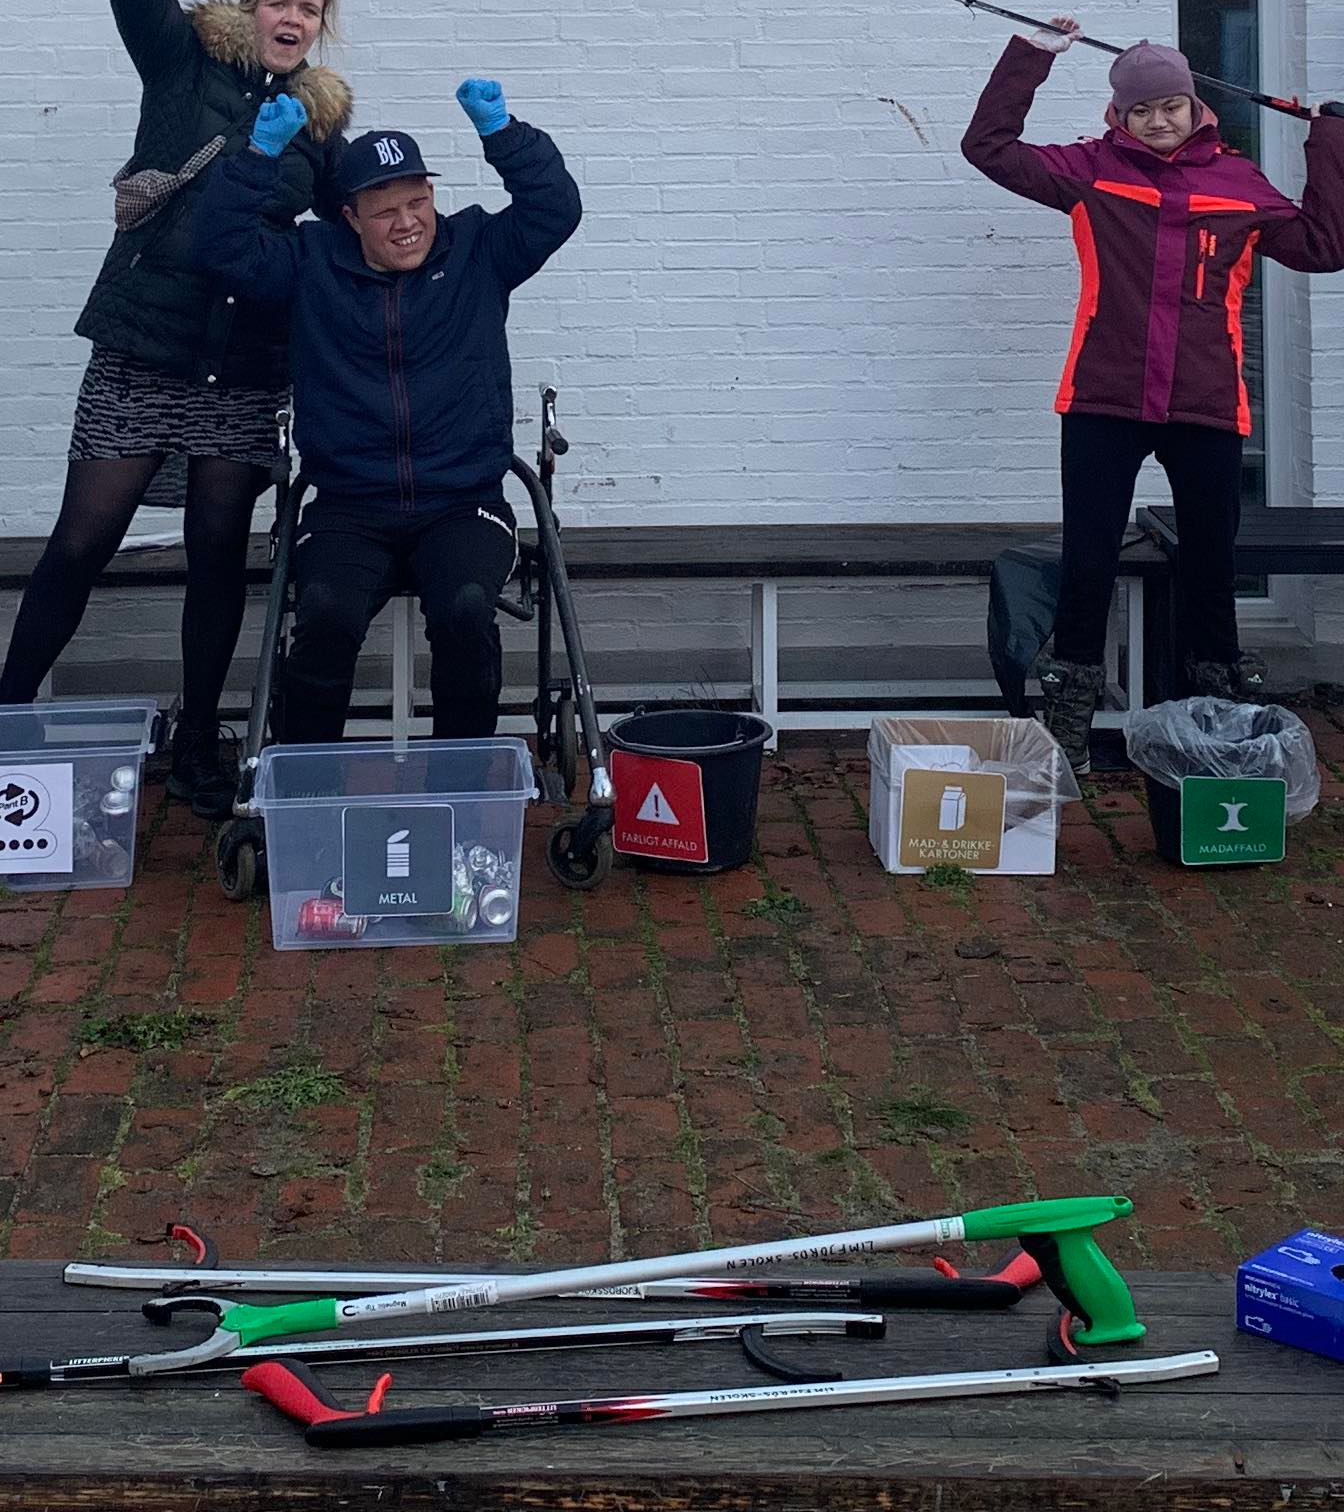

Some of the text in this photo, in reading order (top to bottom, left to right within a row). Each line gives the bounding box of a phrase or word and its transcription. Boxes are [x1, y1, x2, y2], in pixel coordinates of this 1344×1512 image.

[20, 795, 29, 806] B
[621, 832, 698, 851] FARLIGT AFFALD
[919, 849, 980, 860] KARTONER
[1199, 843, 1267, 854] MADAFFALD
[378, 892, 418, 905] METAL
[1244, 1283, 1278, 1300] nitrylex
